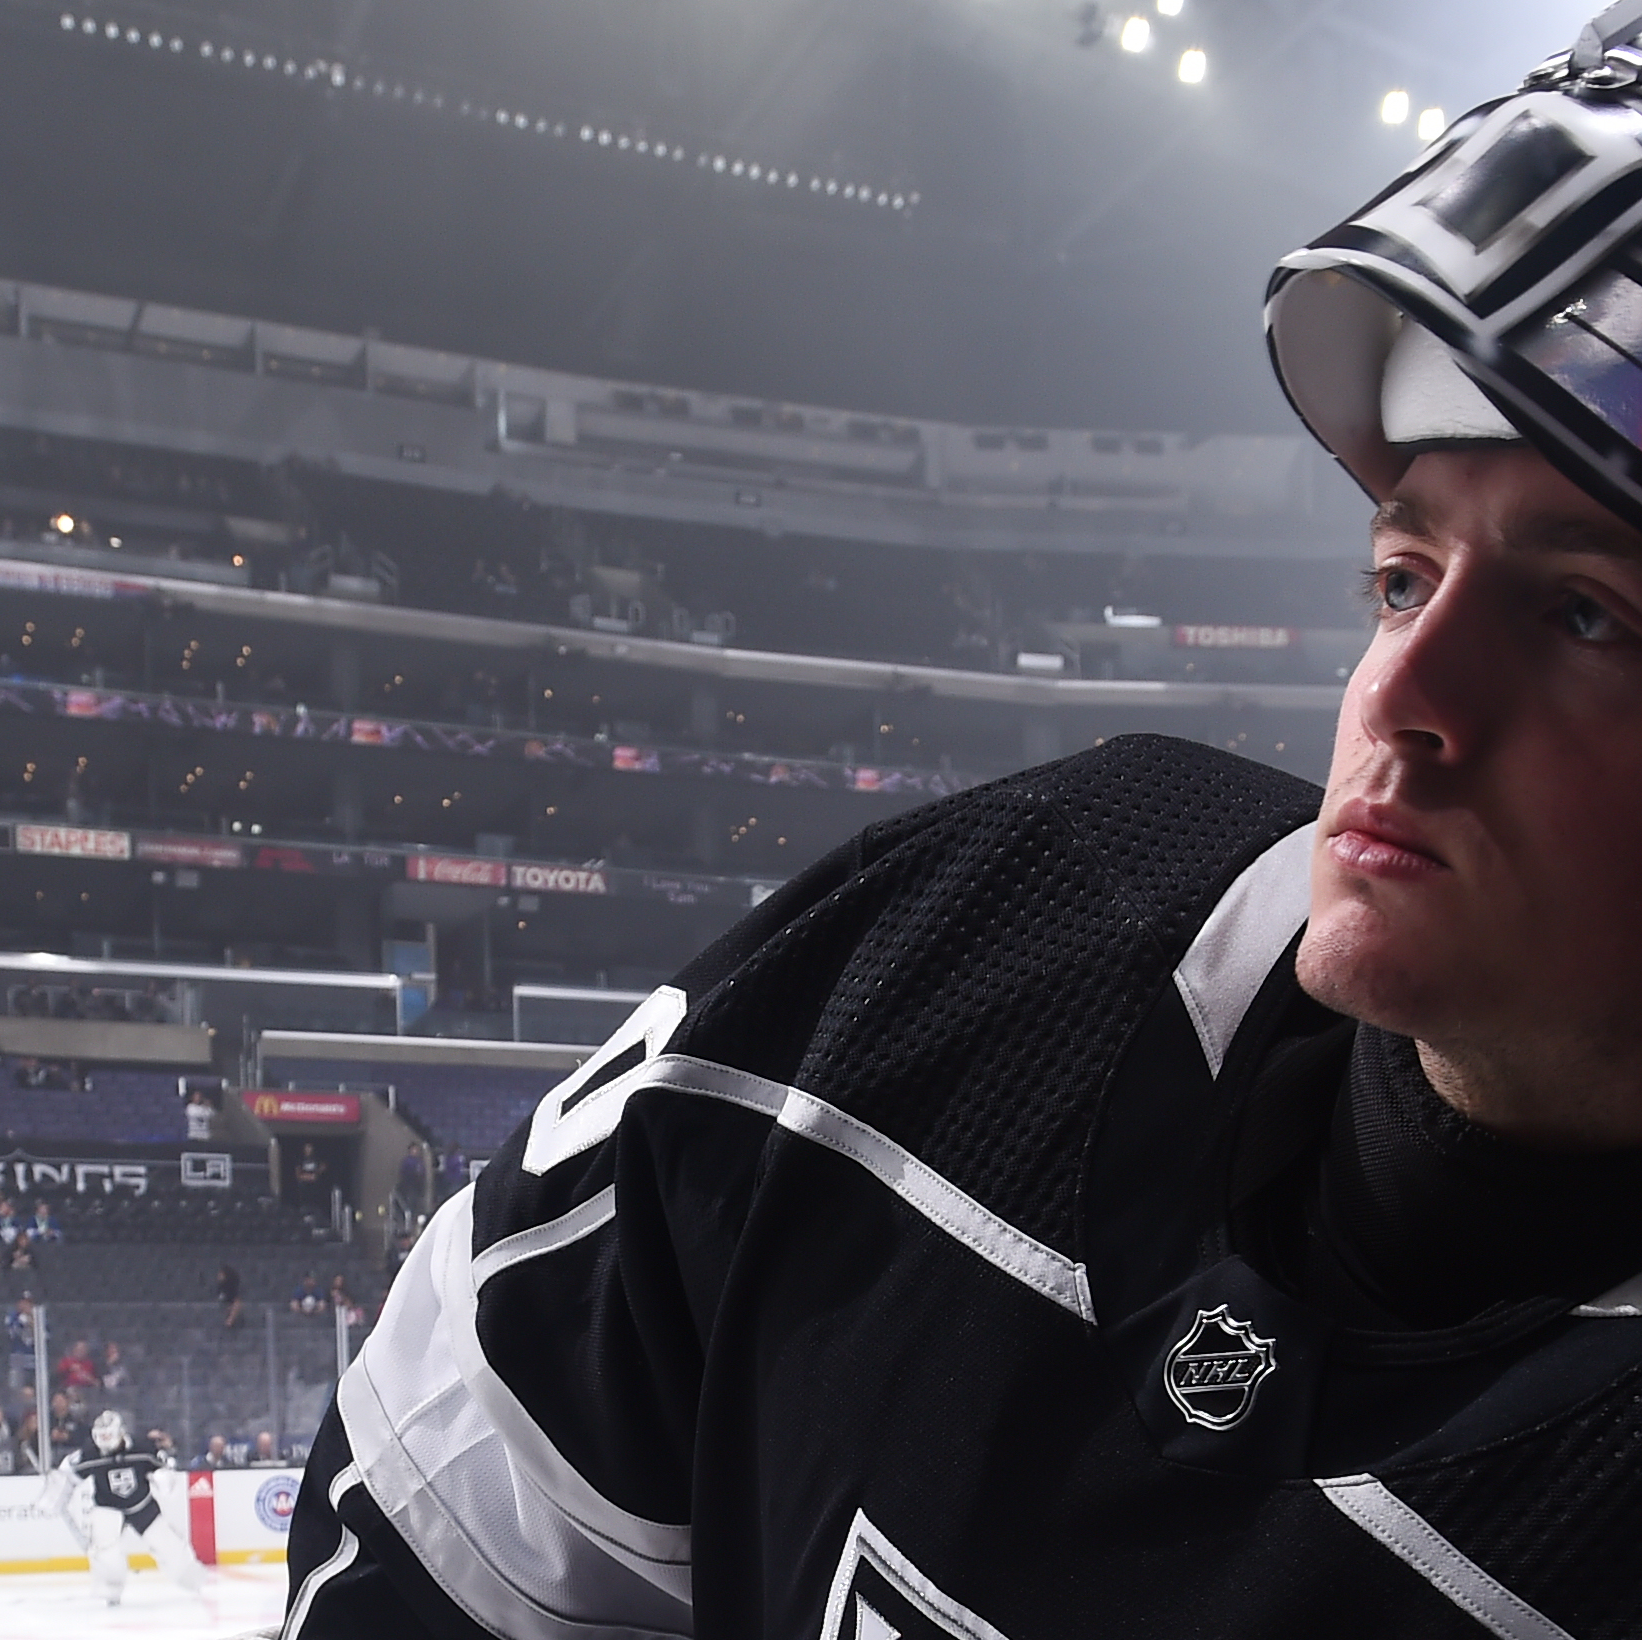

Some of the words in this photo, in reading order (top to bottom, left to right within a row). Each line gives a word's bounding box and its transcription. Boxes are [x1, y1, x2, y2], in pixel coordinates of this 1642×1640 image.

[1183, 626, 1290, 648] TOSHIBA
[17, 826, 127, 858] STAPLES
[513, 866, 606, 893] TOYOTA
[1178, 1358, 1250, 1386] NHL
